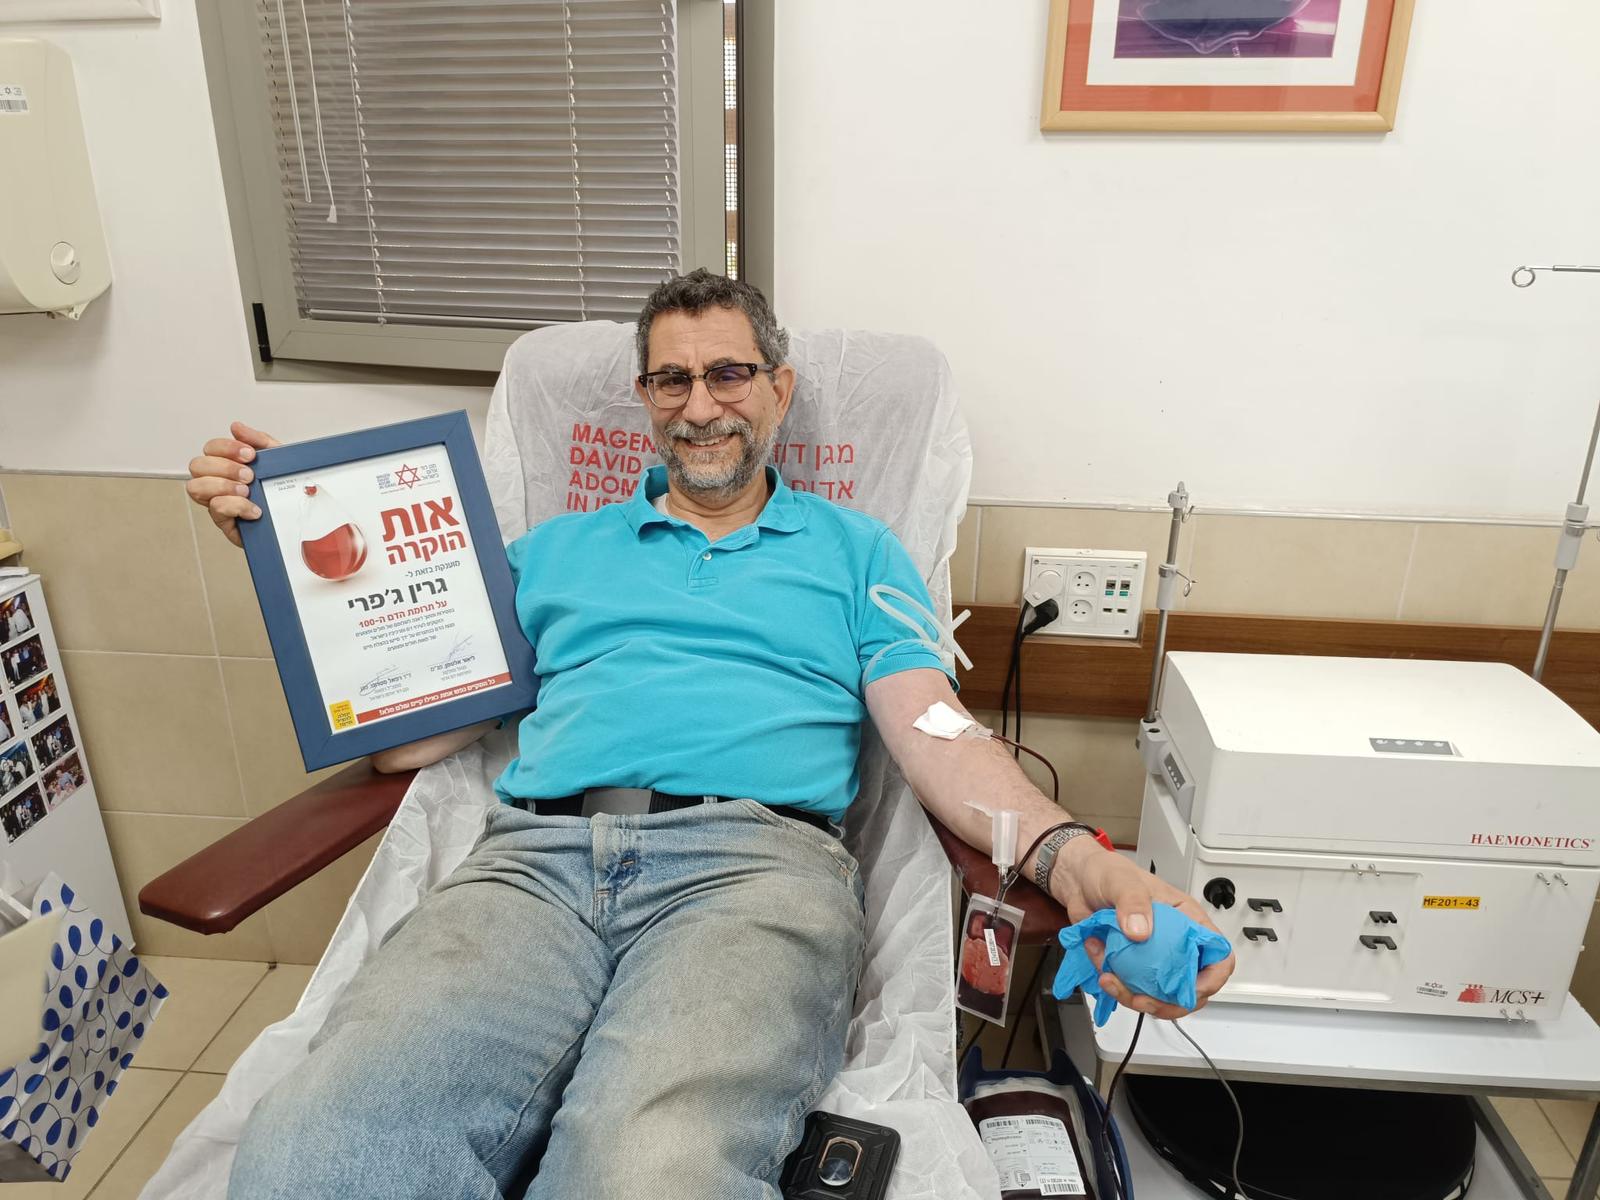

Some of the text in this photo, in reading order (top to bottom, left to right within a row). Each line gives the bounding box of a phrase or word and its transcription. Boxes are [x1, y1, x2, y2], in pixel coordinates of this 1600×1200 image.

[572, 423, 656, 453] MAGEN
[570, 446, 642, 474] DAVID
[815, 444, 854, 471] מגן
[569, 469, 640, 497] ADOM
[566, 491, 589, 513] IN
[380, 496, 460, 542] אות
[385, 530, 466, 565] הוקרה
[415, 566, 434, 577] בזאת
[435, 560, 461, 572] מוענקת
[408, 577, 448, 604] גרין
[359, 600, 448, 628] על תרומת הדם ה-100
[1471, 833, 1592, 849] HAEMONETICS
[1489, 989, 1545, 1004] MCS+
